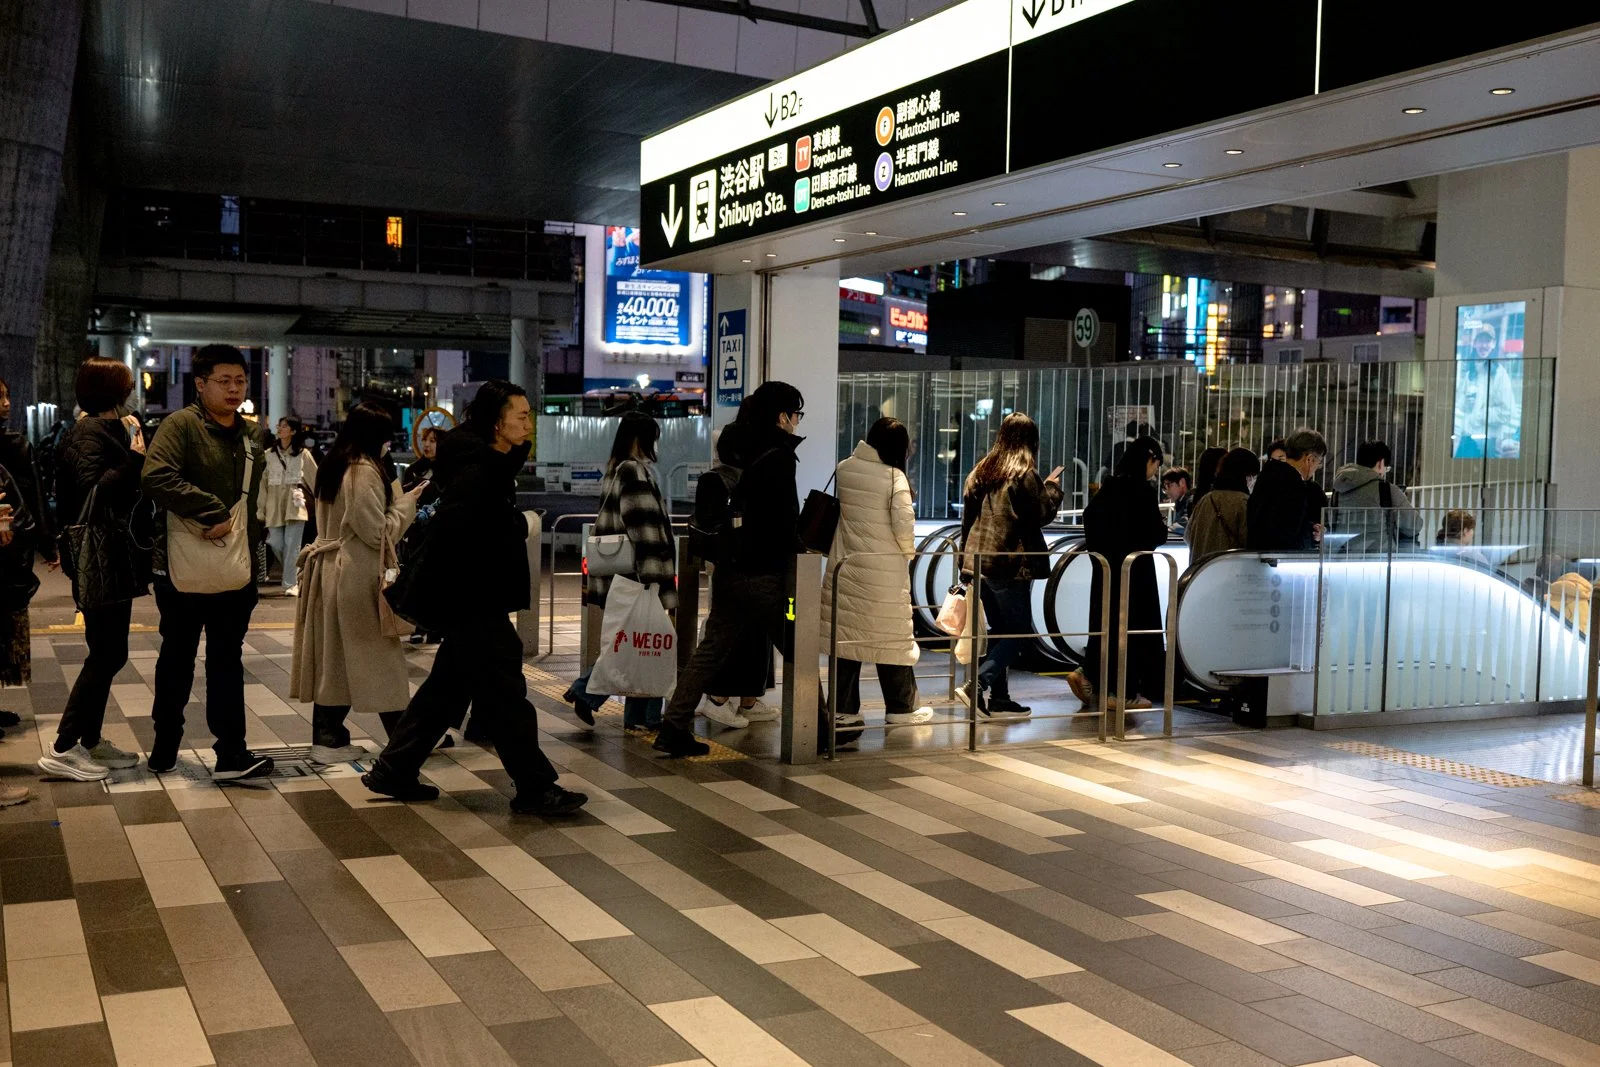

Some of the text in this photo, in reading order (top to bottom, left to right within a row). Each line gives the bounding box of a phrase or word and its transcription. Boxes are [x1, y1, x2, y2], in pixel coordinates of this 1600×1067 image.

[781, 90, 803, 121] B2F
[896, 89, 941, 124] 副都心線
[812, 125, 841, 152] 東横線
[895, 108, 960, 141] Fukutoshin Line
[812, 145, 853, 168] Toyoko Line
[895, 137, 940, 170] 半蔵門線
[719, 152, 765, 200] 渋谷駅
[811, 163, 858, 195] 田園都市線
[894, 158, 958, 188] Hanzomon Line
[718, 192, 787, 229] Shibuya Sta.
[811, 183, 871, 210] Den-en-toshi Line
[616, 315, 648, 325] プレゼント
[624, 297, 676, 316] 40,000
[1076, 315, 1092, 342] 59
[722, 339, 741, 354] TAXI
[633, 631, 673, 650] WEGO
